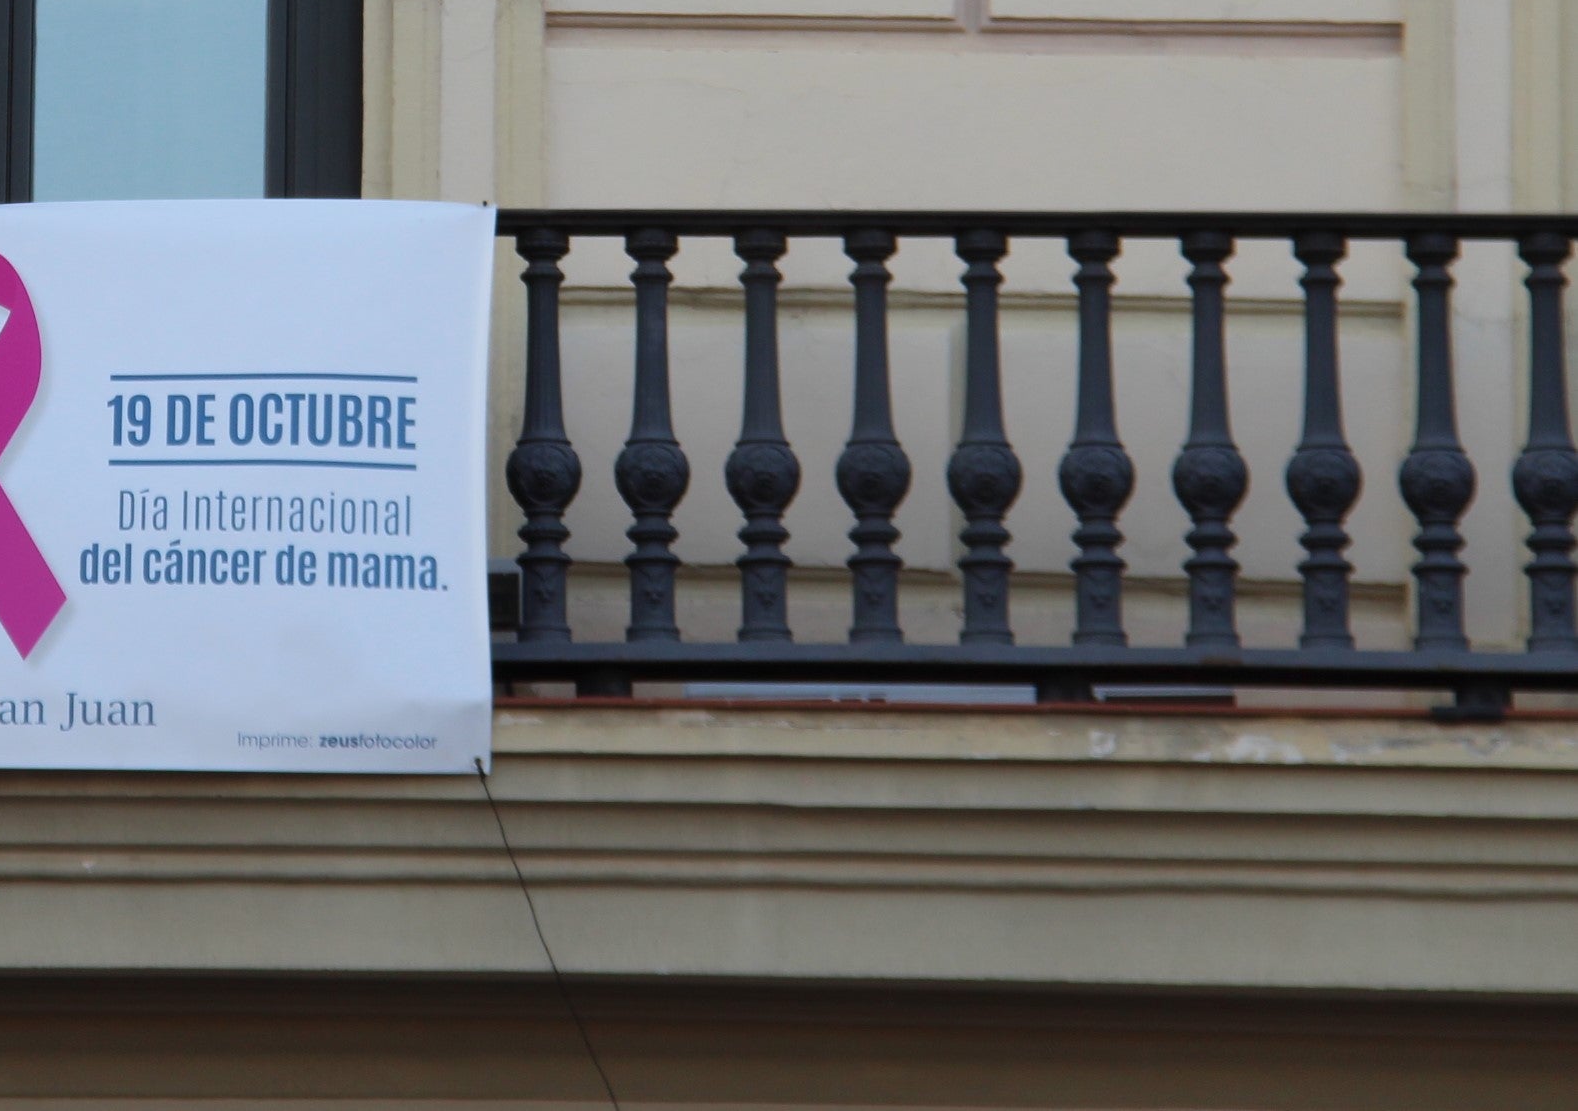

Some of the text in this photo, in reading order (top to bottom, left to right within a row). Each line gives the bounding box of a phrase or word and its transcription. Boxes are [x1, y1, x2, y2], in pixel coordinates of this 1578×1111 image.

[107, 393, 417, 450] 19 DE OCTUBRE
[119, 489, 411, 537] Día Internacional
[79, 539, 449, 592] del cáncer de mama.
[60, 692, 157, 732] Juan
[238, 732, 438, 750] Imprime: zeusfotocolor
